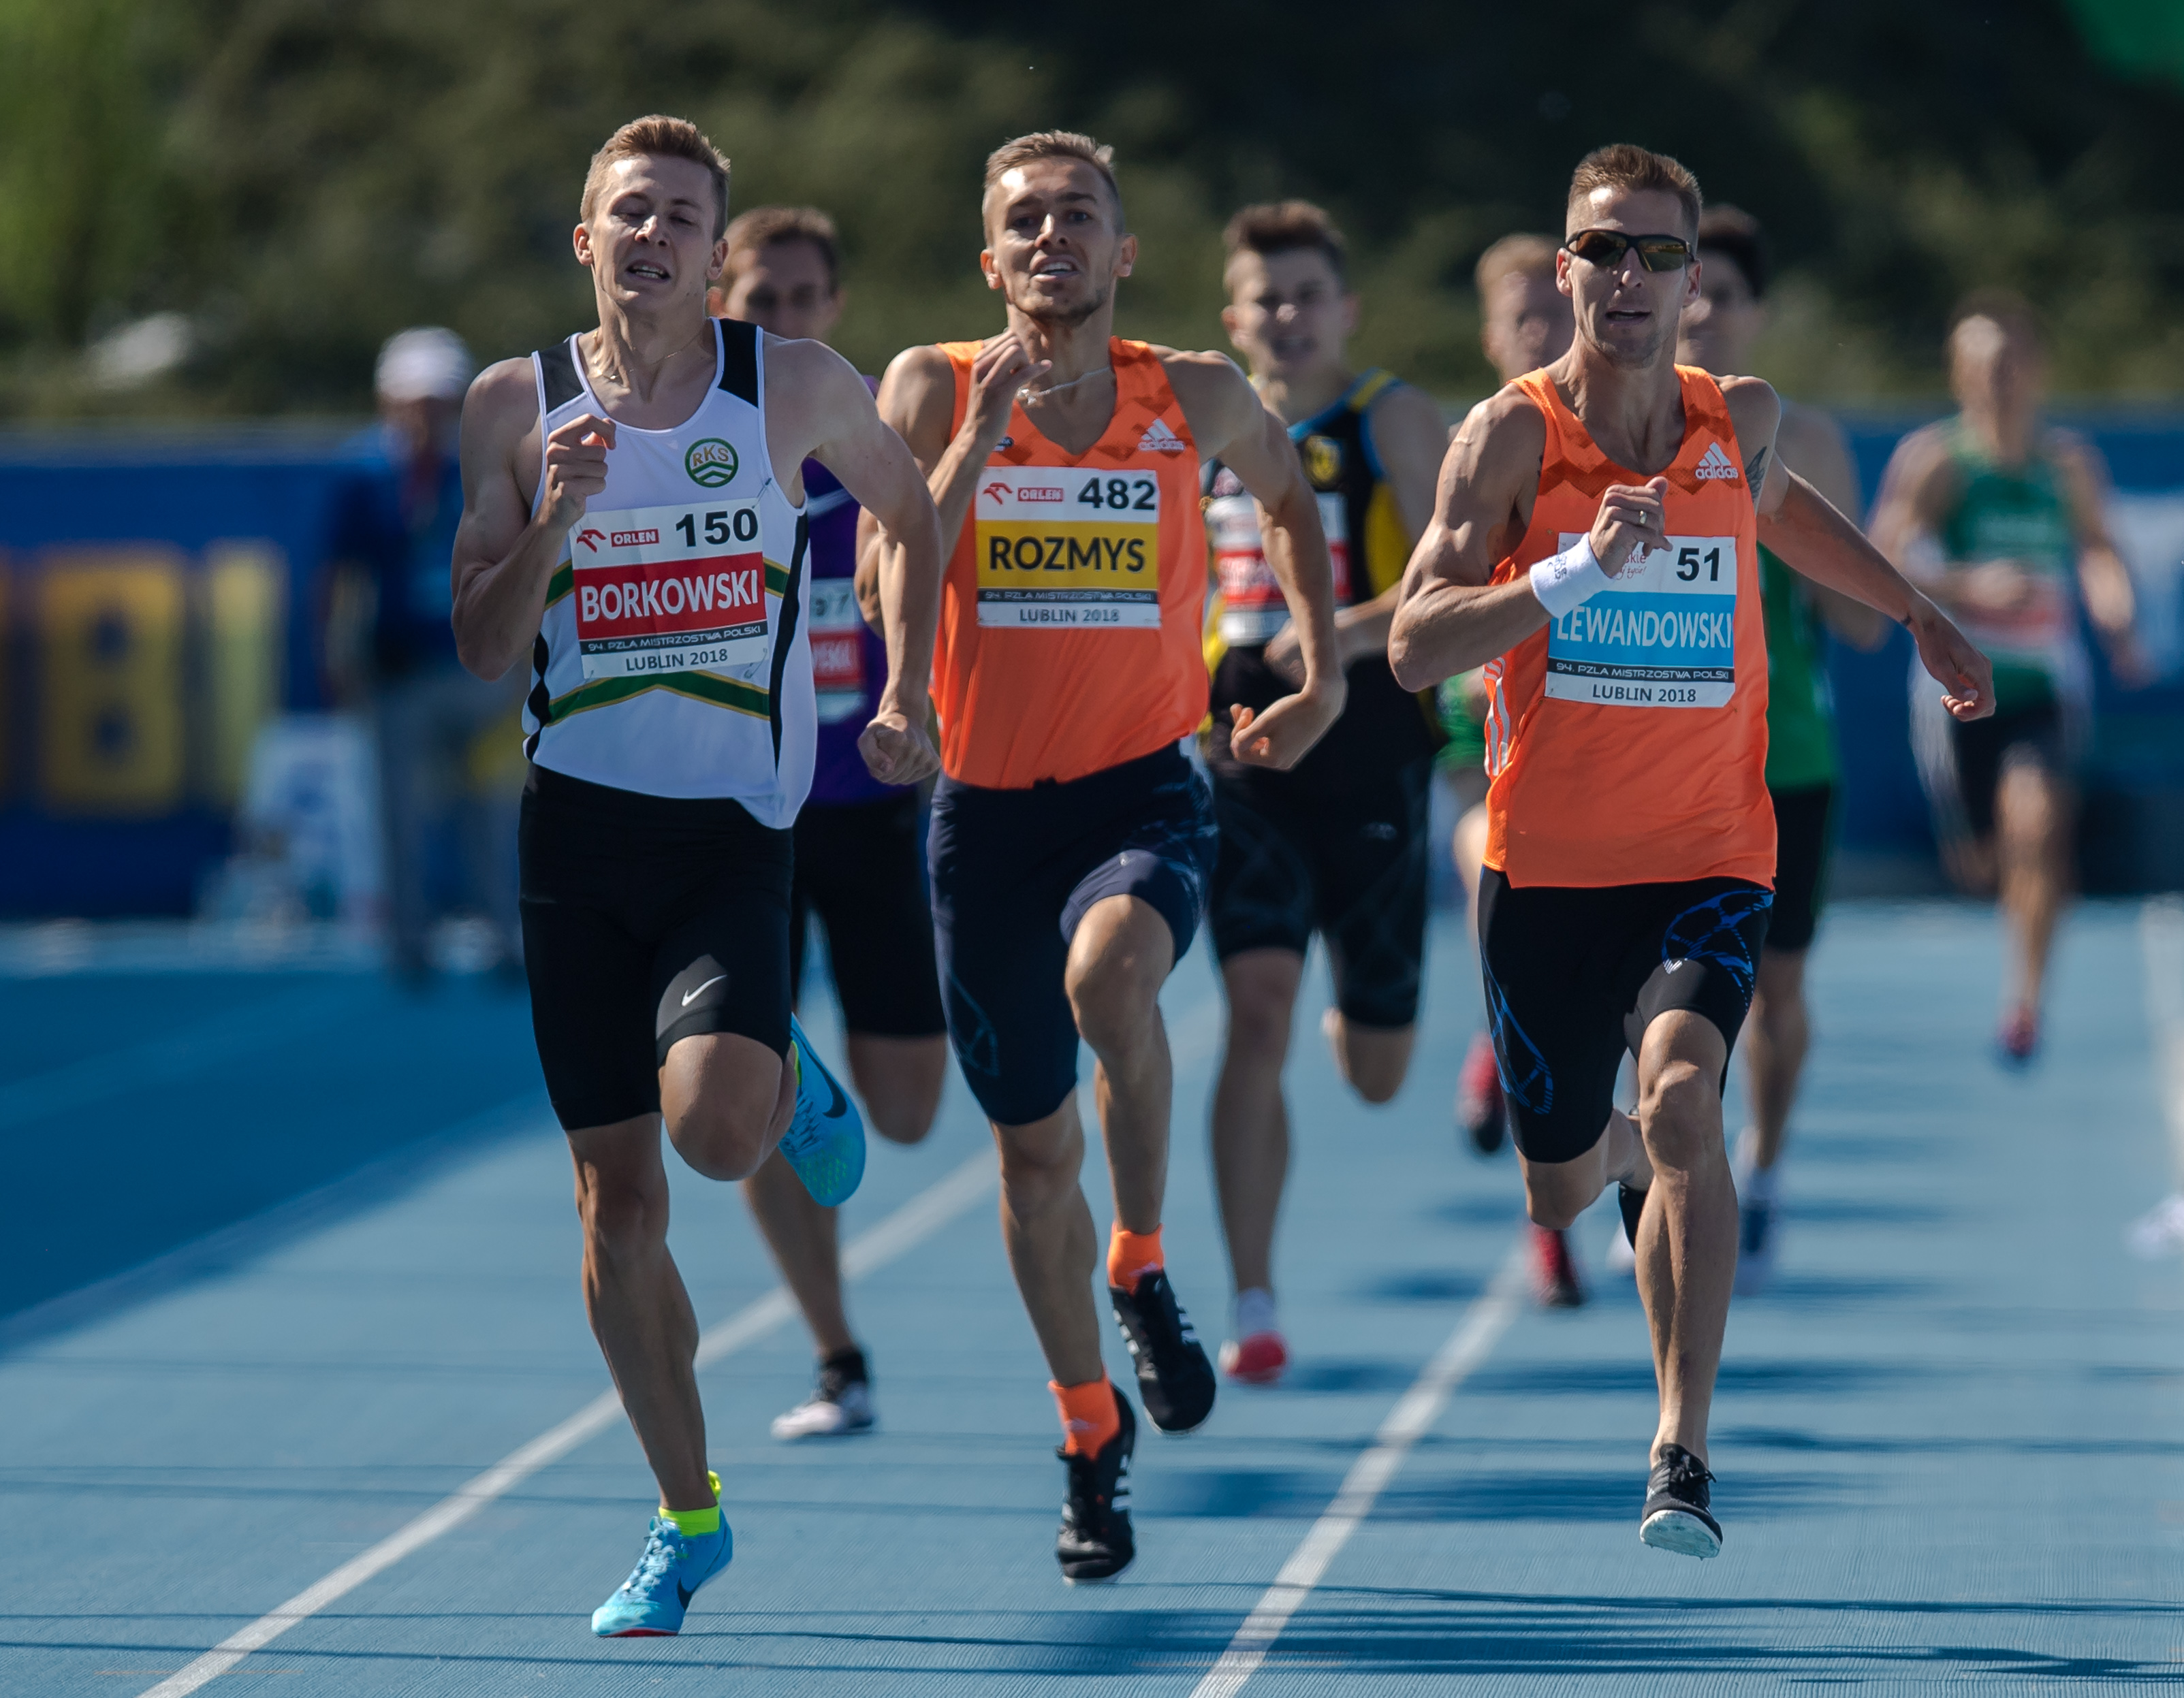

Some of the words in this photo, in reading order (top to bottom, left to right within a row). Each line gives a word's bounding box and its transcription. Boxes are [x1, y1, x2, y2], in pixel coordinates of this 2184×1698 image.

[693, 445, 729, 467] RKS
[1695, 465, 1738, 479] adidas
[1020, 490, 1062, 500] ORLEN
[1077, 477, 1156, 511] 482
[614, 530, 656, 545] ORLEN
[676, 508, 759, 547] 150
[989, 536, 1145, 573] ROZMYS
[1676, 547, 1720, 582] 51
[581, 569, 759, 622] BORKOWSKI
[1019, 609, 1076, 622] LUBLIN
[1083, 609, 1120, 622] 2018
[1557, 605, 1732, 648] LEWANDOWSKI
[588, 643, 606, 652] 94.
[608, 639, 637, 650] PZLA
[640, 631, 722, 647] MISTRZOSTWA
[724, 625, 761, 638] POLSKI
[626, 653, 684, 671] LUBLIN
[690, 649, 728, 666] 2018
[1556, 662, 1574, 672] 94.
[1578, 664, 1609, 675] PZLA
[1611, 668, 1691, 679] MISTRZOSTWA
[1693, 670, 1729, 679] POLSKI
[1592, 684, 1651, 702] LUBLIN
[1658, 688, 1696, 703] 2018
